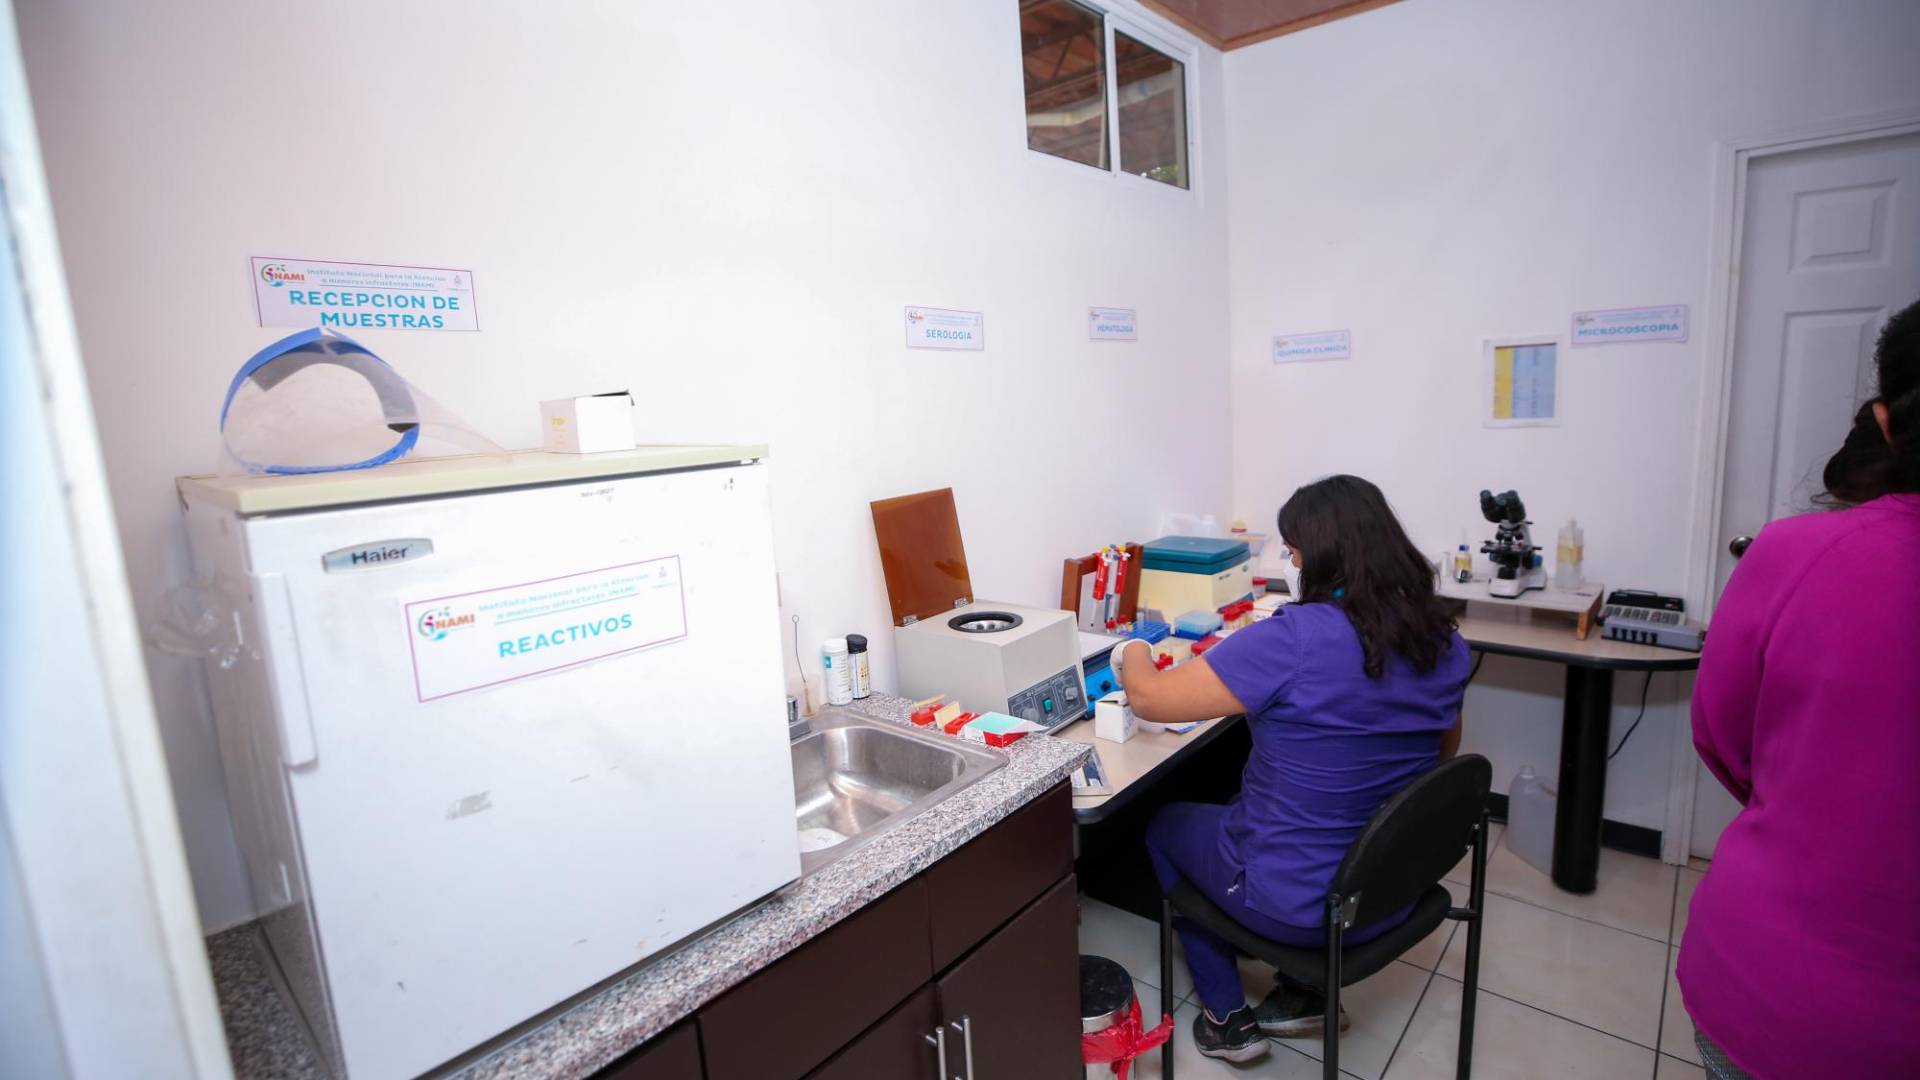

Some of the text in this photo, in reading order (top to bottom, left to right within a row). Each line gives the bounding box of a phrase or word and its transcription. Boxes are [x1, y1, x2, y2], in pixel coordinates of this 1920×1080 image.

[289, 290, 460, 310] RECEPCION DE
[320, 312, 444, 328] MUESTRAS
[926, 329, 972, 340] SEROLOGIA
[1578, 323, 1679, 336] MICROCOSCOPIA
[351, 546, 408, 565] Haier
[498, 613, 633, 657] REACTIVOS
